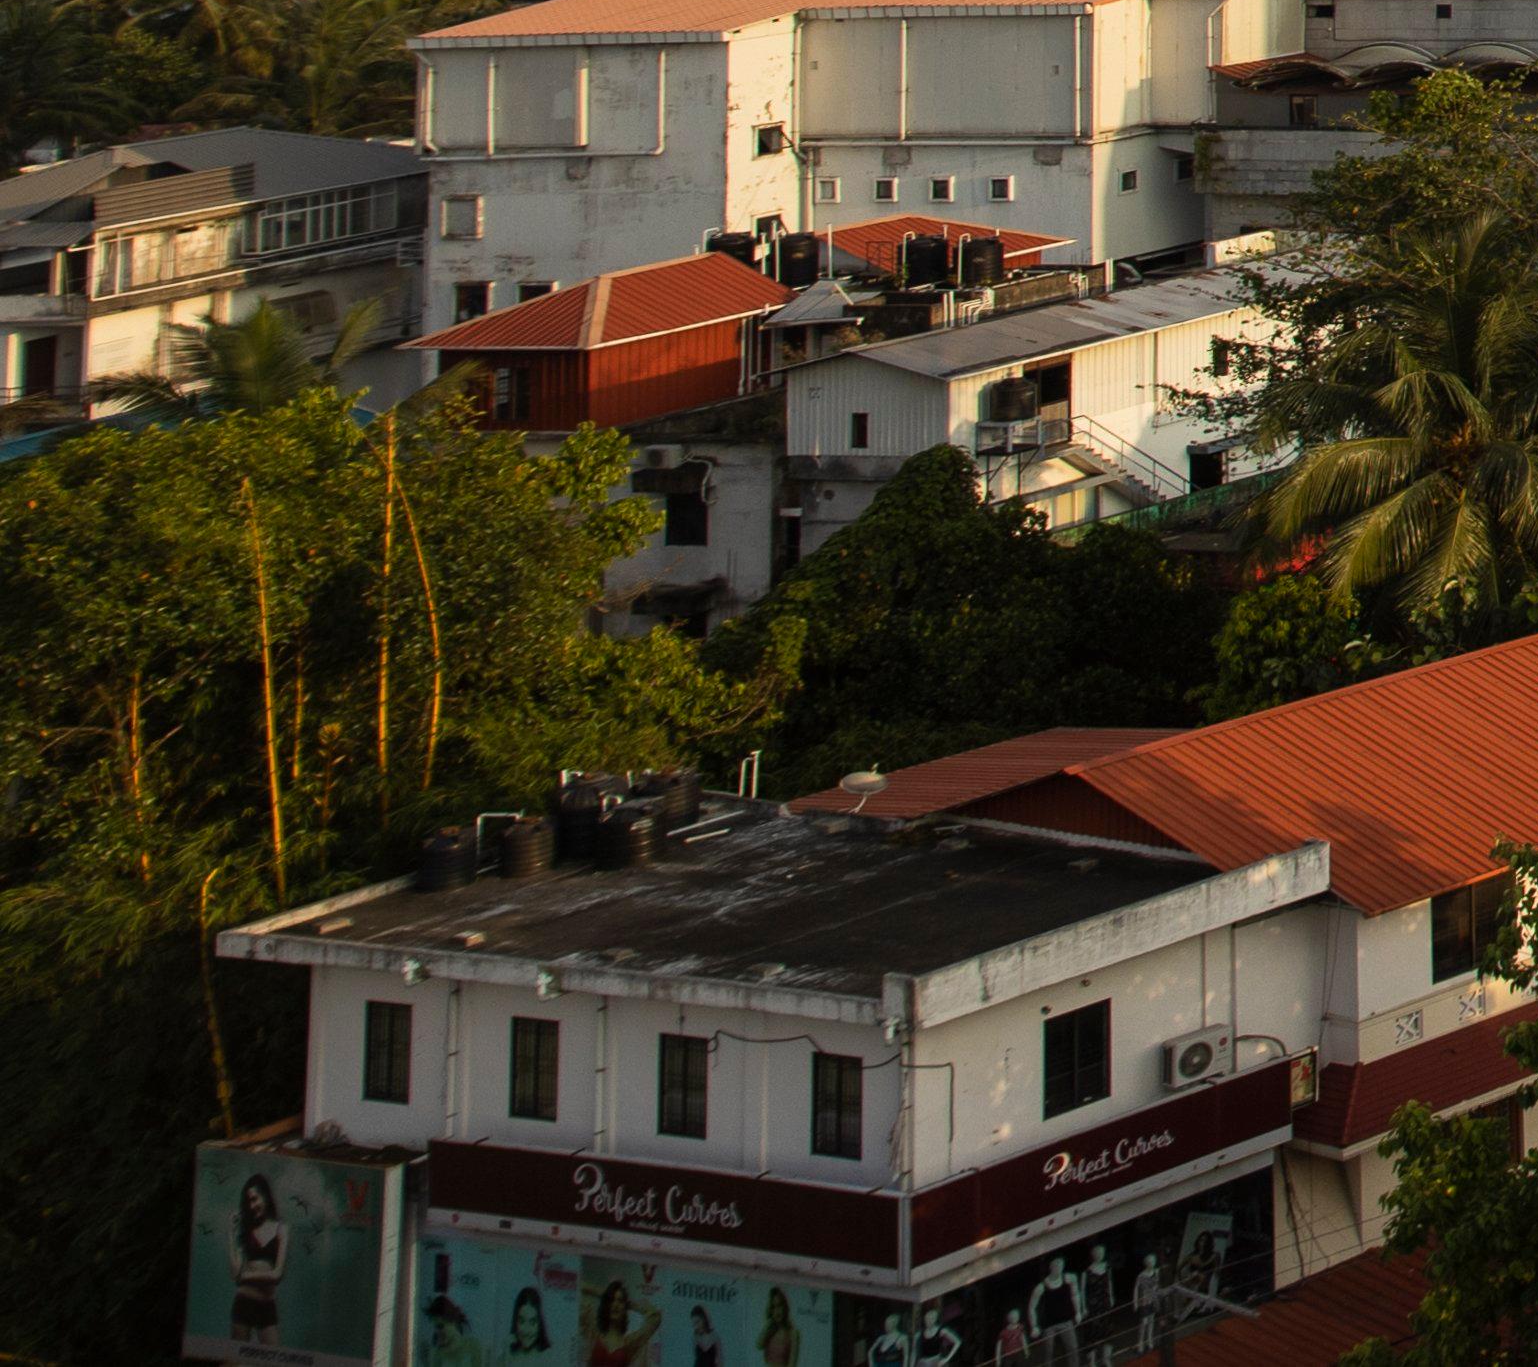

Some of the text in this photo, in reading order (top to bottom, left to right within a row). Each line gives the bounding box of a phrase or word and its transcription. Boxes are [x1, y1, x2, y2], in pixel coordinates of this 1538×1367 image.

[1043, 1149, 1112, 1191] Perfect
[1114, 1130, 1175, 1164] Curves
[573, 1163, 744, 1229] Perfect Curves
[672, 1278, 739, 1303] amanté
